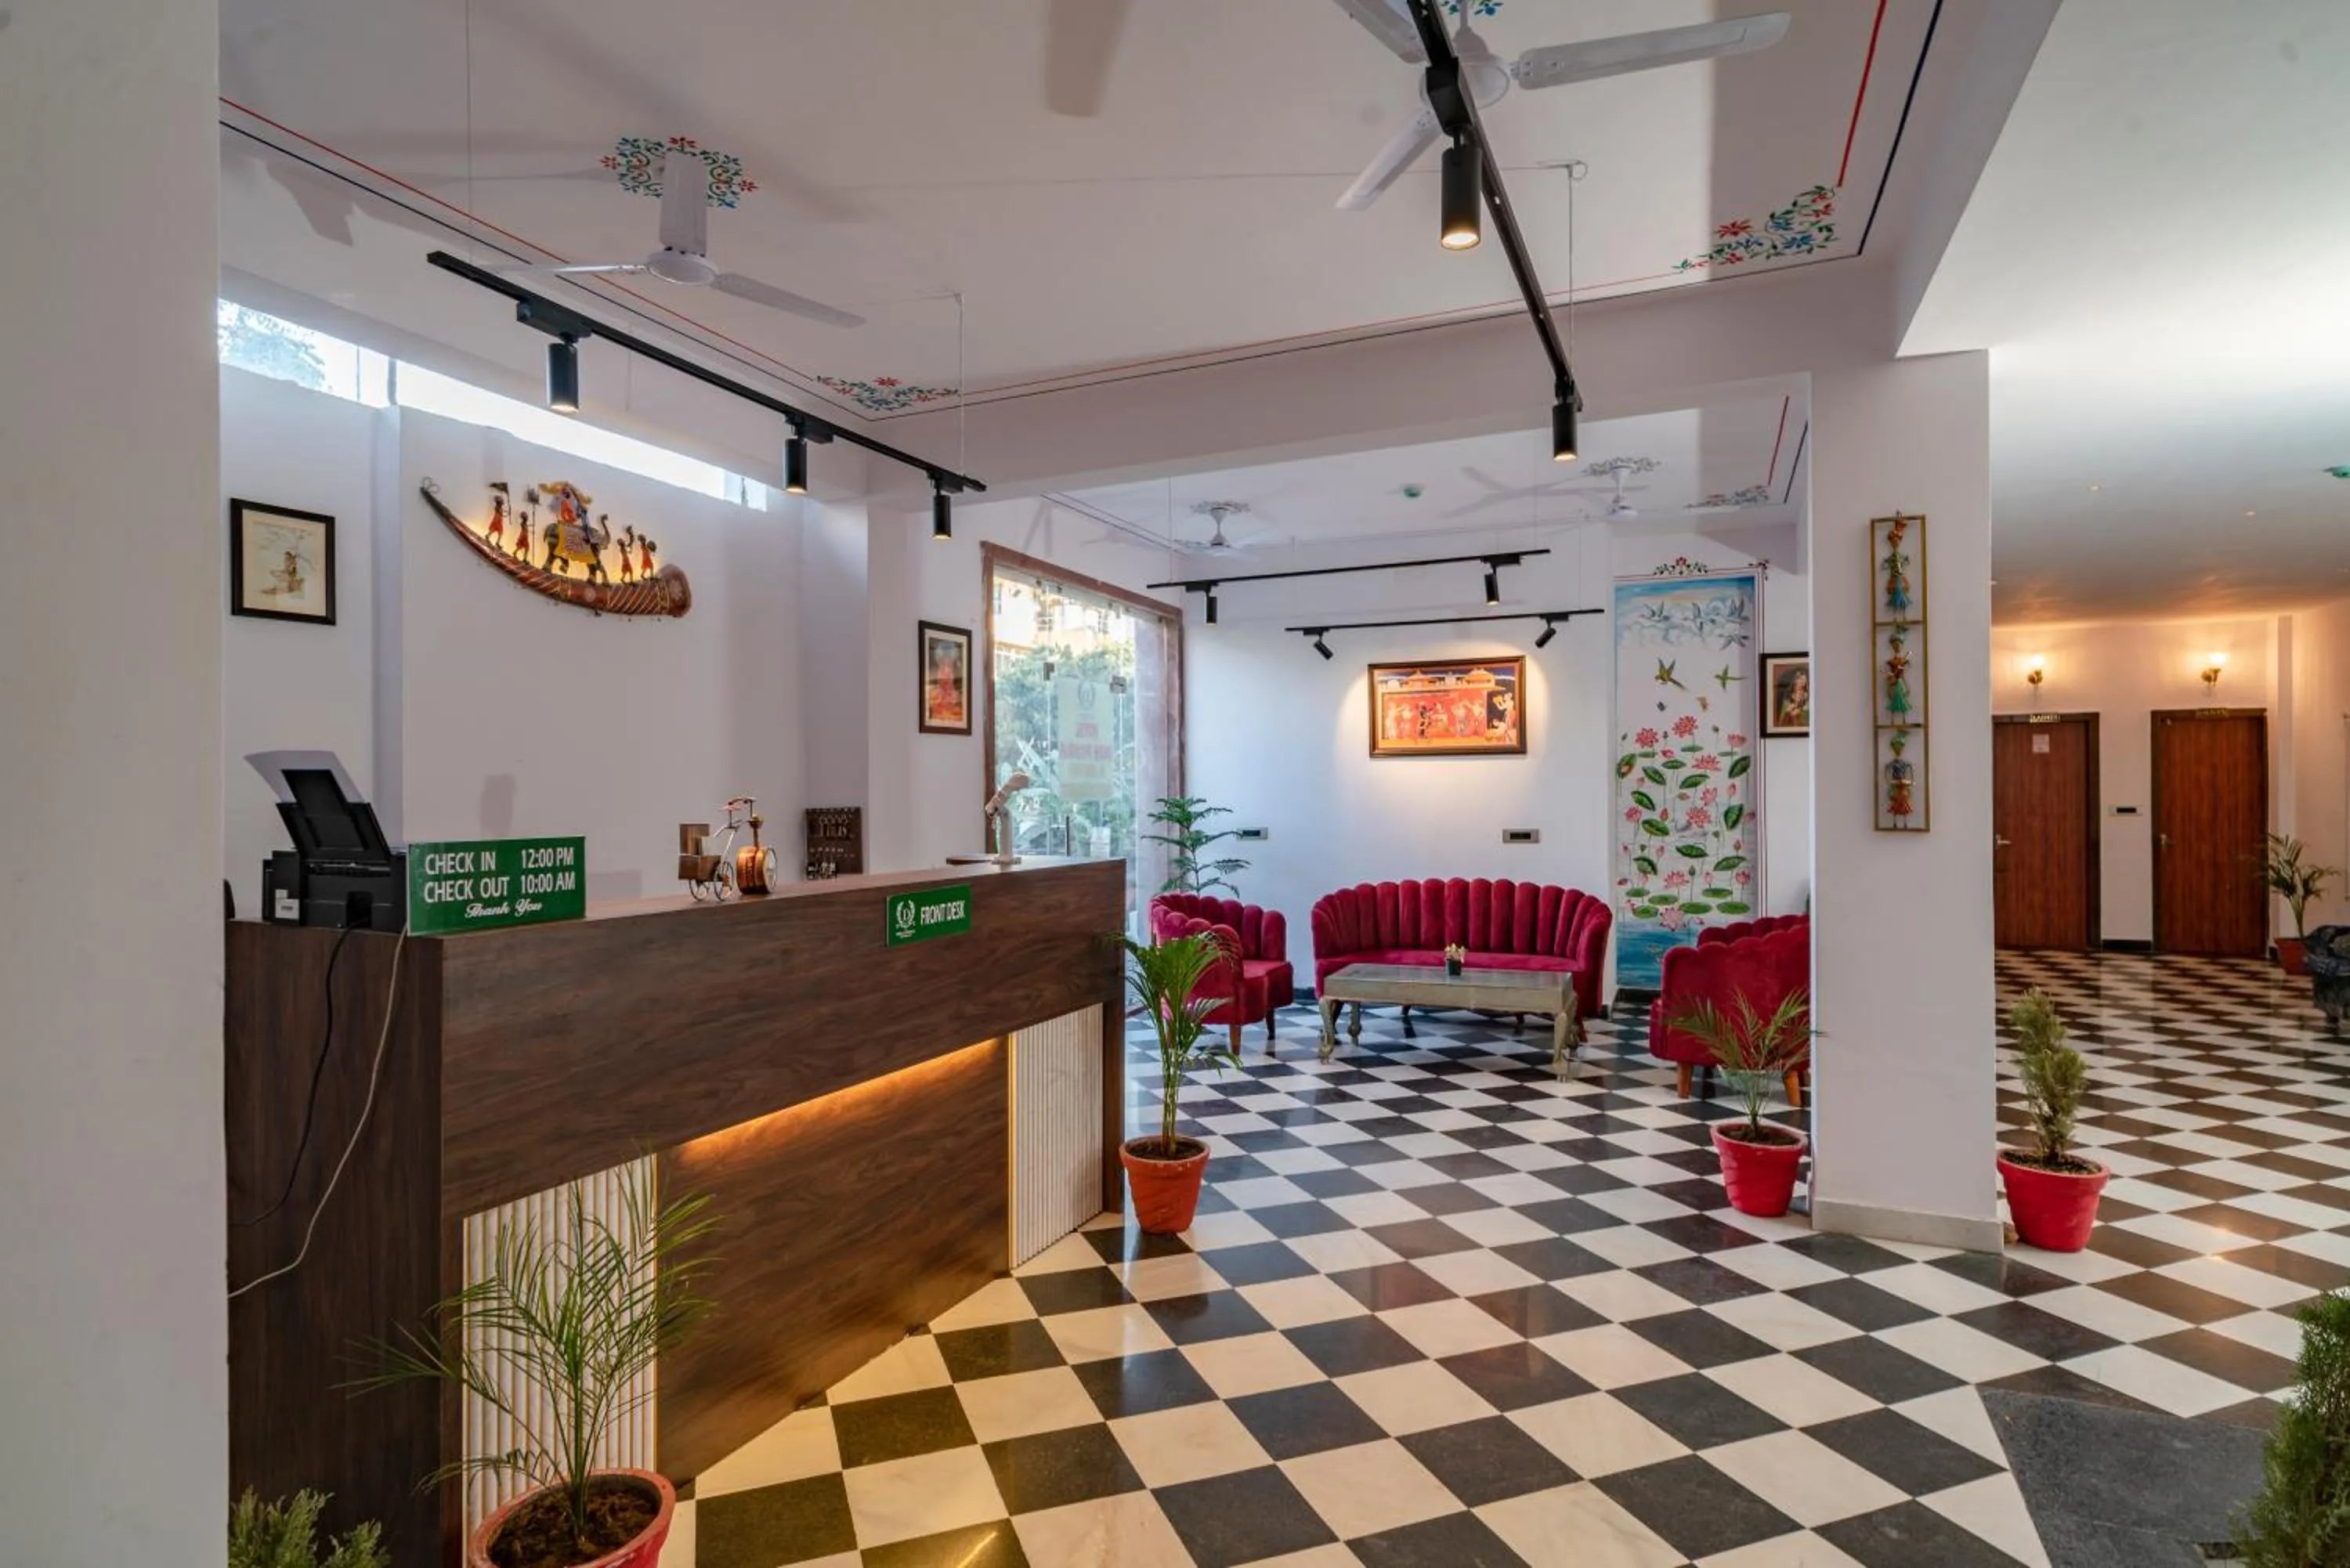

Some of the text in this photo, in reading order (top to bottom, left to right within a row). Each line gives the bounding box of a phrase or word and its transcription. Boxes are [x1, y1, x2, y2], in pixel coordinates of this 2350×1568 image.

[425, 847, 574, 875] CHECK IN 12:00 PM
[424, 871, 576, 903] CHECK OUT 10:00 AM
[465, 898, 543, 919] Thank You
[920, 900, 965, 926] FRONT DESK
